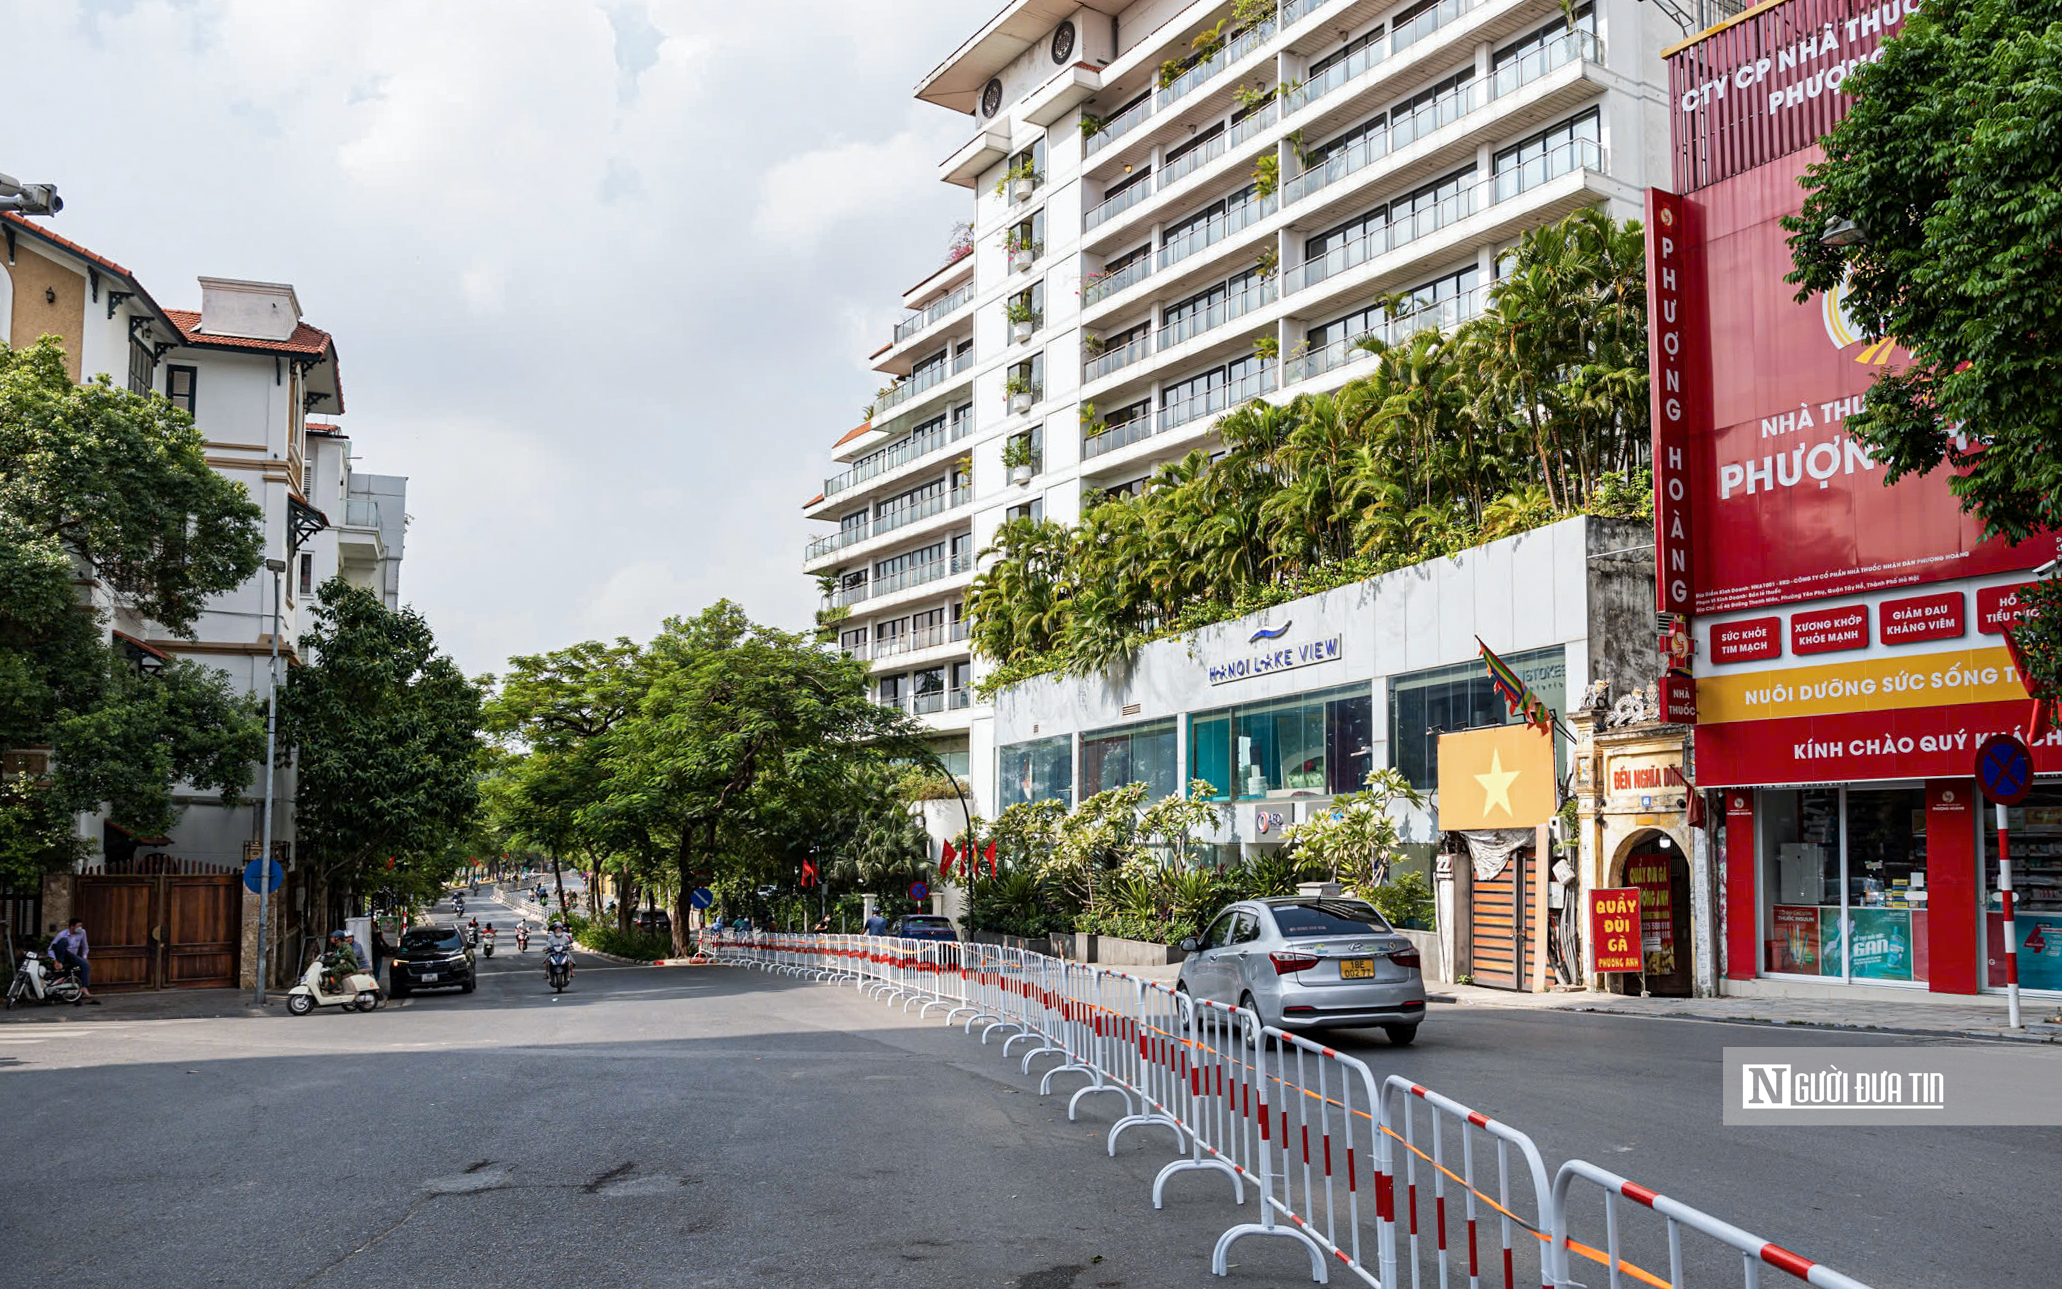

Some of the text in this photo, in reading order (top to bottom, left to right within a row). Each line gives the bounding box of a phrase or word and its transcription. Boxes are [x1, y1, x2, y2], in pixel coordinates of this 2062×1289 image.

[1681, 75, 1728, 112] CTY
[1735, 58, 1771, 89] CP
[1778, 22, 1839, 73] NHÀ
[1662, 236, 1687, 603] PHƯỢNG HOÀNG
[1761, 394, 1870, 439] NHÀ THU
[1721, 435, 1894, 500] PHƯỢN
[1847, 566, 1860, 575] NHÀ
[1892, 604, 1948, 620] GIẢM ĐAU
[1795, 614, 1862, 633] XƯƠNG KHỚP
[1886, 617, 1956, 635] KHÁNG VIÊM
[1721, 625, 1767, 642] SỨC KHỎE
[1799, 630, 1859, 646] KHỎE MẠNH
[1721, 641, 1768, 655] TIM MẠCH
[1209, 638, 1338, 682] HANOI LAKE VIEW
[1745, 683, 1793, 705] NUÔI
[1800, 678, 1877, 701] DƯỠNG
[1882, 670, 1925, 692] SỨC
[1931, 661, 1998, 688] SỐNG
[1672, 686, 1690, 699] NHÀ
[1668, 700, 1696, 717] THUỐC
[1794, 738, 1843, 760] KÍNH
[1849, 732, 1914, 756] CHÀO
[1920, 728, 1967, 752] QUÝ
[1436, 855, 1452, 872] 22
[1596, 892, 1637, 914] QUẨY
[1603, 916, 1630, 933] ĐÙI
[1607, 935, 1628, 952] GÀ
[1625, 957, 1639, 968] ANH
